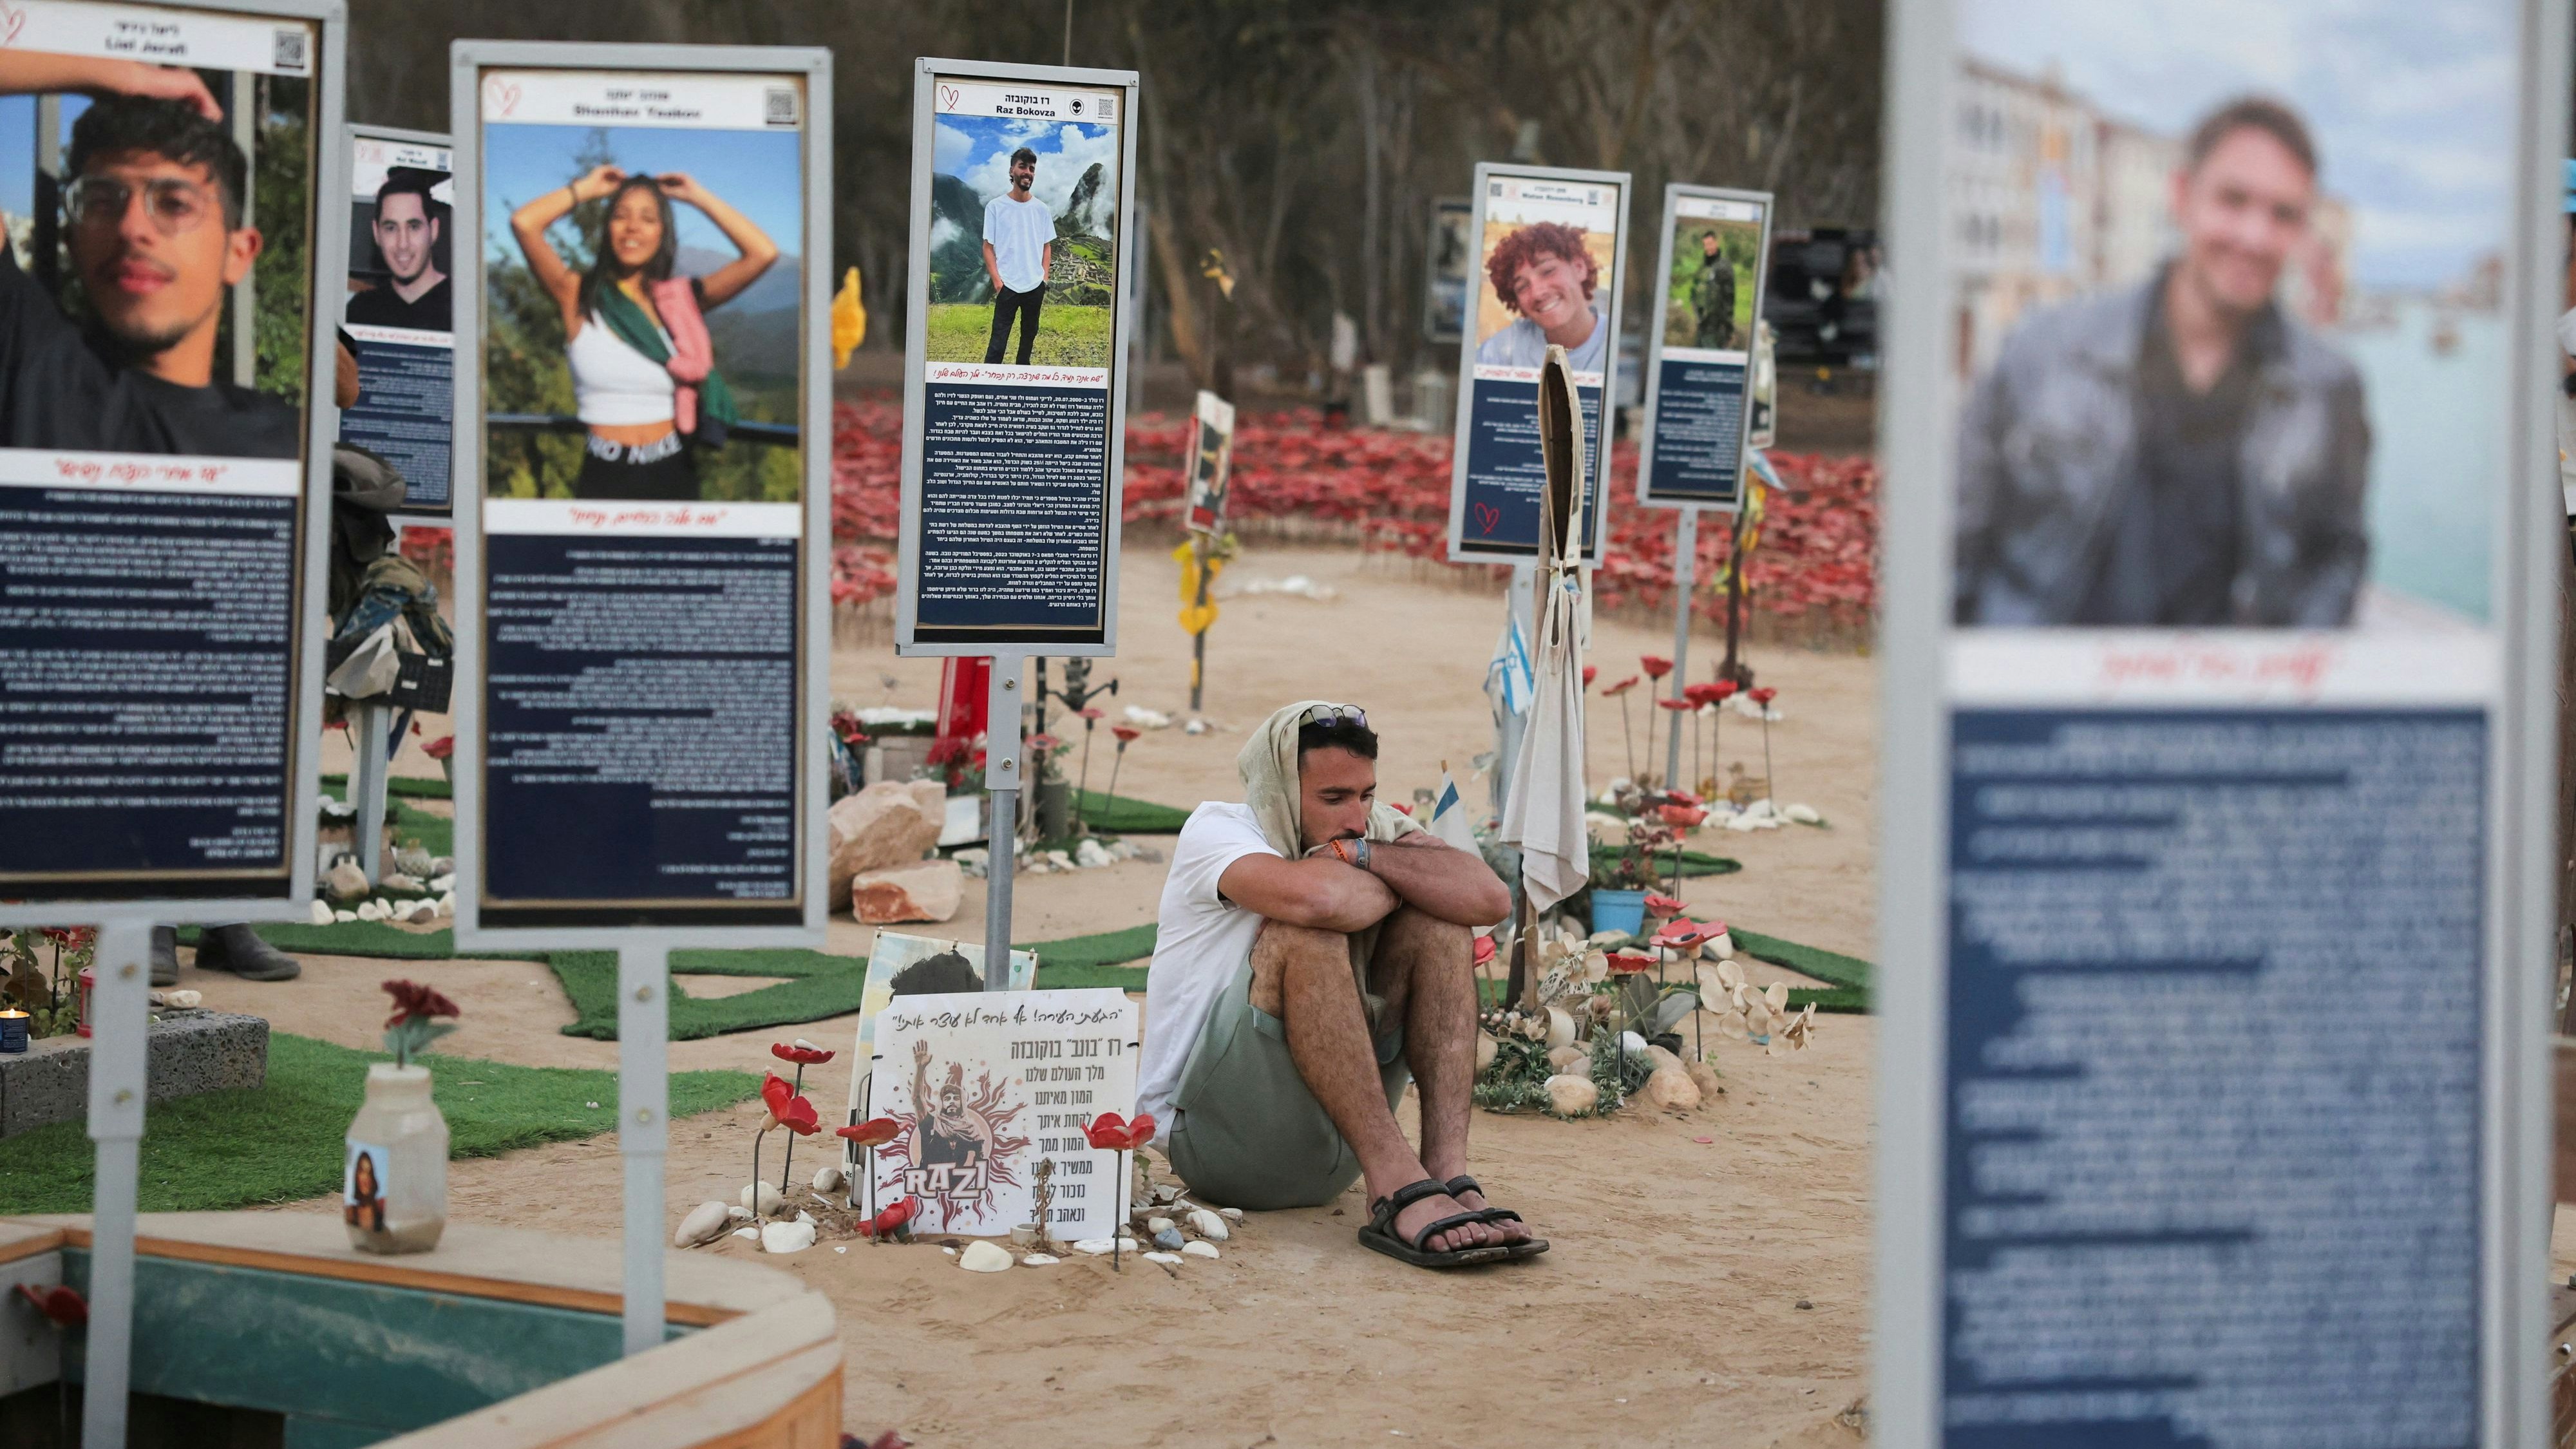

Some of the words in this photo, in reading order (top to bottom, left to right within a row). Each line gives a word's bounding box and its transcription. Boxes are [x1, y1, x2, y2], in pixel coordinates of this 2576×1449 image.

[1005, 95, 1038, 104] בוקובזה
[996, 106, 1013, 114] Raz
[1016, 107, 1055, 117] Bokovza
[930, 1012, 961, 1028] עוצר
[965, 1007, 981, 1028] לא
[982, 1011, 1007, 1026] אחד
[1011, 1040, 1061, 1060] בוקובזה
[1108, 1038, 1121, 1056] רז
[1026, 1066, 1047, 1082] שלנו
[1051, 1066, 1081, 1081] העולם
[1085, 1065, 1104, 1082] מלך
[1035, 1091, 1066, 1105] מאיתנו
[1071, 1090, 1092, 1106] המון
[1037, 1115, 1061, 1130] איתך
[1064, 1112, 1092, 1128] לקחת
[1038, 1138, 1058, 1153] ממך
[1063, 1137, 1084, 1153] המון
[1061, 1160, 1092, 1177] ממשיך
[903, 1159, 989, 1200] RAZI
[1060, 1184, 1085, 1198] נזכור
[1056, 1208, 1084, 1222] ונאהב
